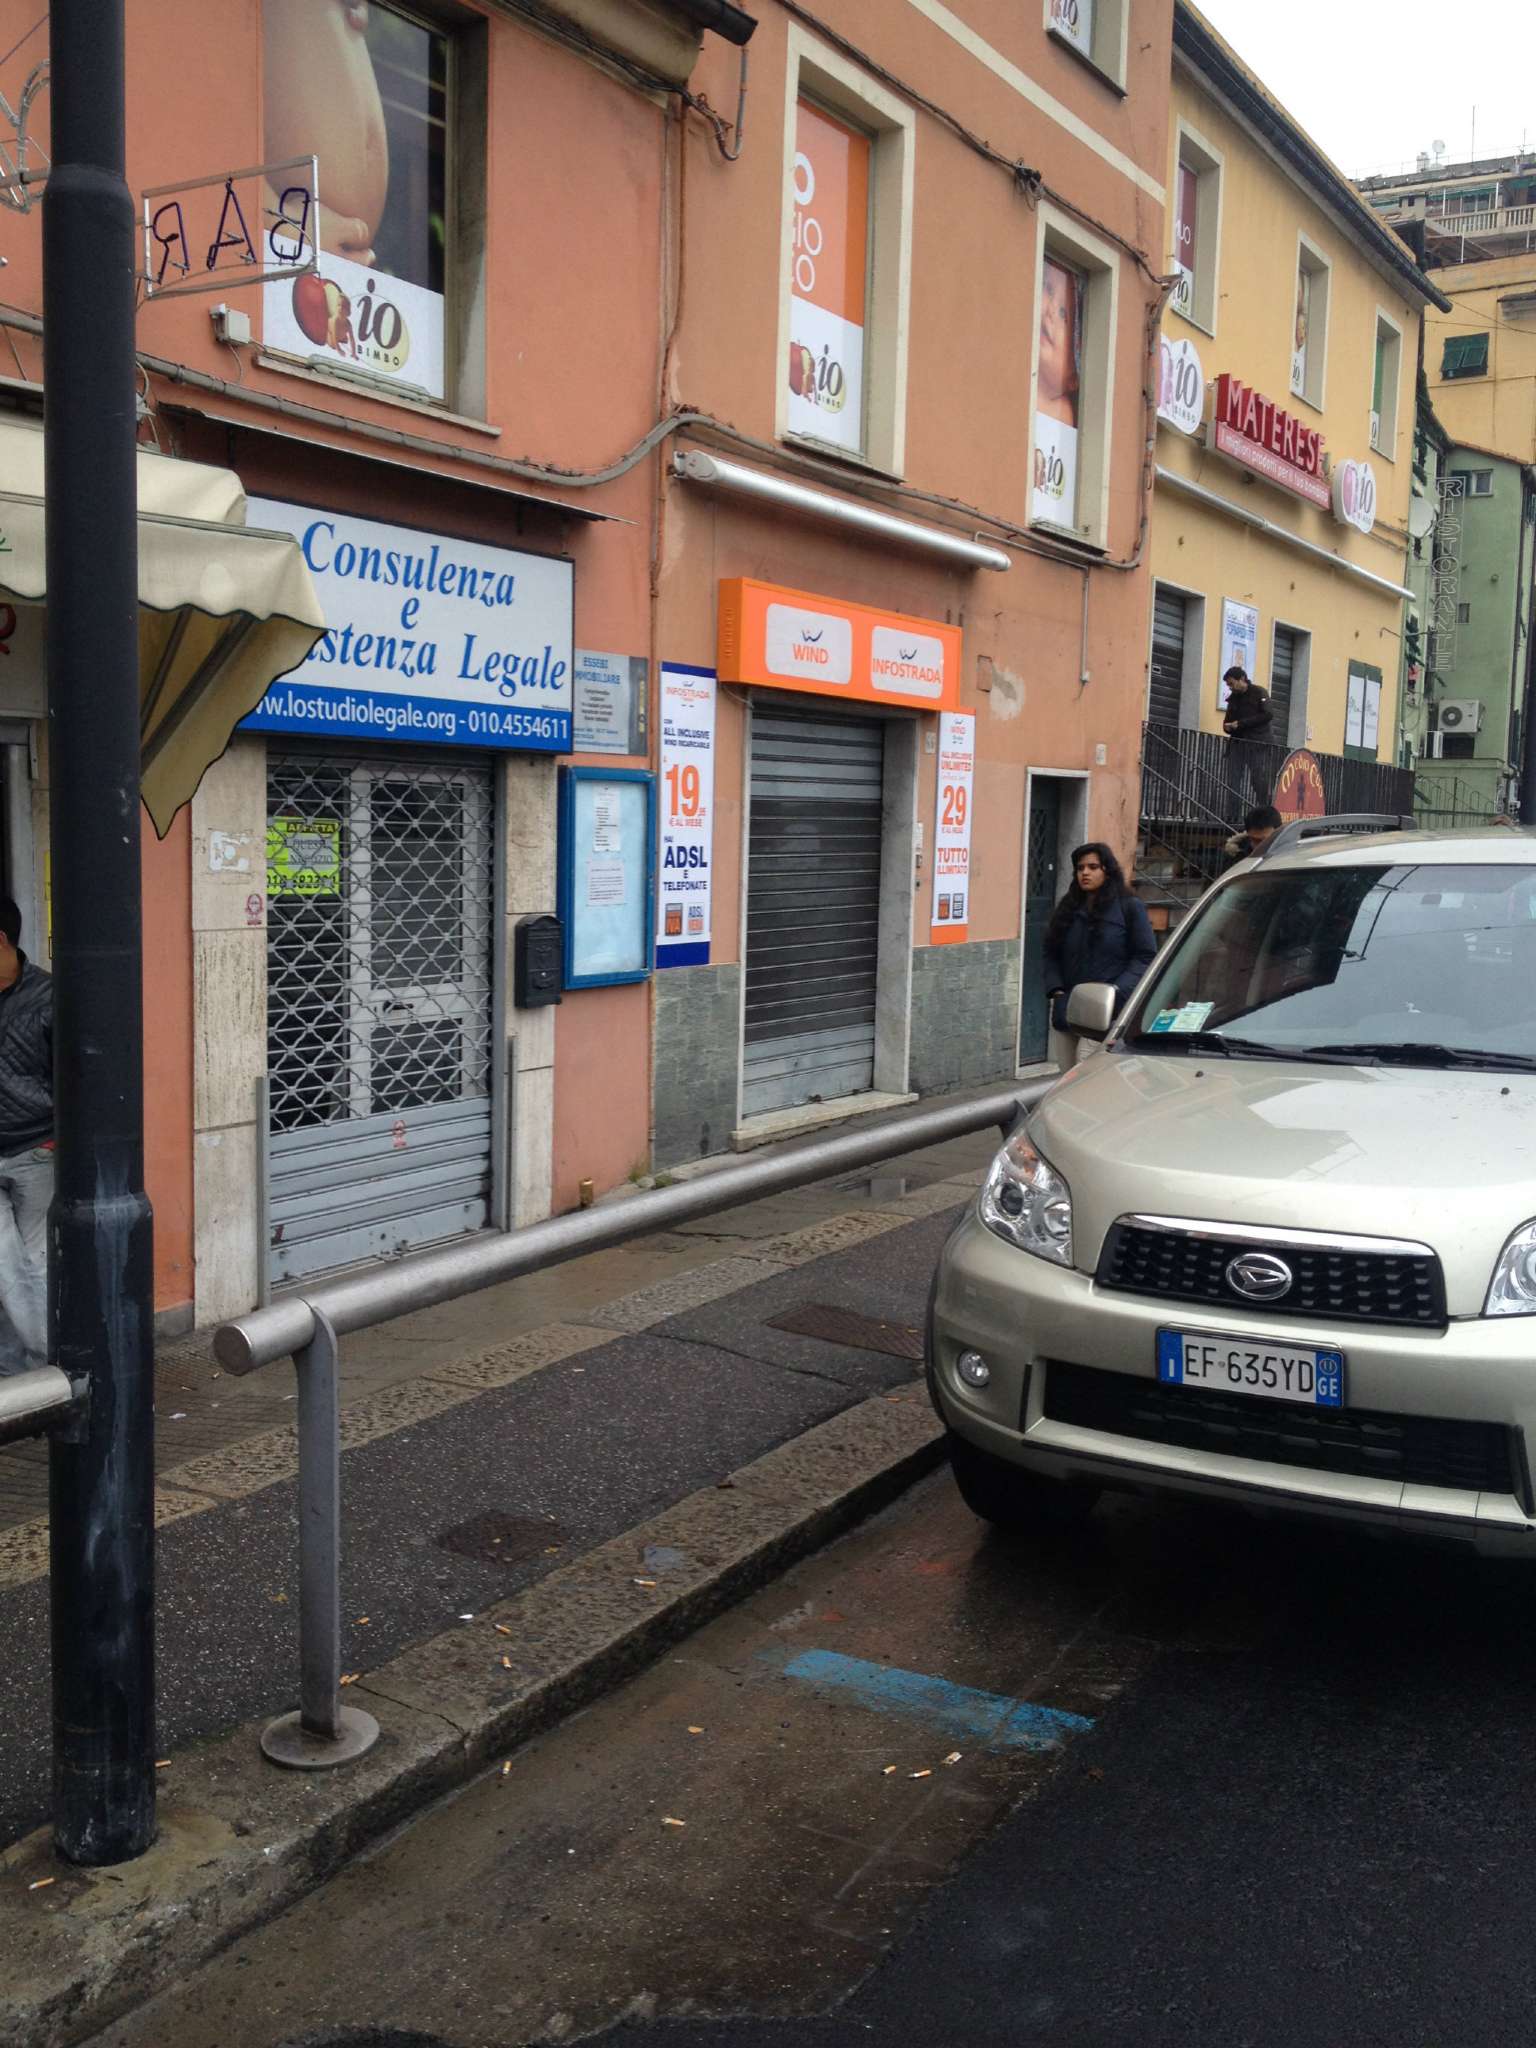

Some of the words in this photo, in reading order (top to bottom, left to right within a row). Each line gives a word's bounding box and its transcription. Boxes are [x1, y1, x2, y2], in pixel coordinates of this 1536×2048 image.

[355, 278, 401, 350] io
[356, 344, 401, 367] BIMBO
[818, 344, 843, 397] io
[1175, 341, 1199, 409] io
[1224, 374, 1327, 479] MATERESE
[1047, 446, 1063, 486] io
[1360, 463, 1373, 514] io
[302, 521, 515, 607] Consulenza
[1431, 478, 1463, 671] RISTORANTE
[400, 596, 420, 630] e
[457, 633, 567, 697] Legale
[792, 642, 830, 665] WIND
[872, 658, 942, 684] INFOSTRADA
[665, 687, 711, 700] INFOSTRADA
[467, 710, 568, 739] 010.4554611
[664, 727, 676, 737] ALL
[678, 728, 711, 740] INCLUSIVE
[941, 761, 972, 772] UNLIMITED
[943, 784, 966, 826] 29
[663, 845, 708, 868] ADSL
[937, 847, 968, 862] TUTTO
[663, 880, 708, 891] TELEFONATE
[683, 869, 689, 879] E
[1317, 1376, 1338, 1398] GE
